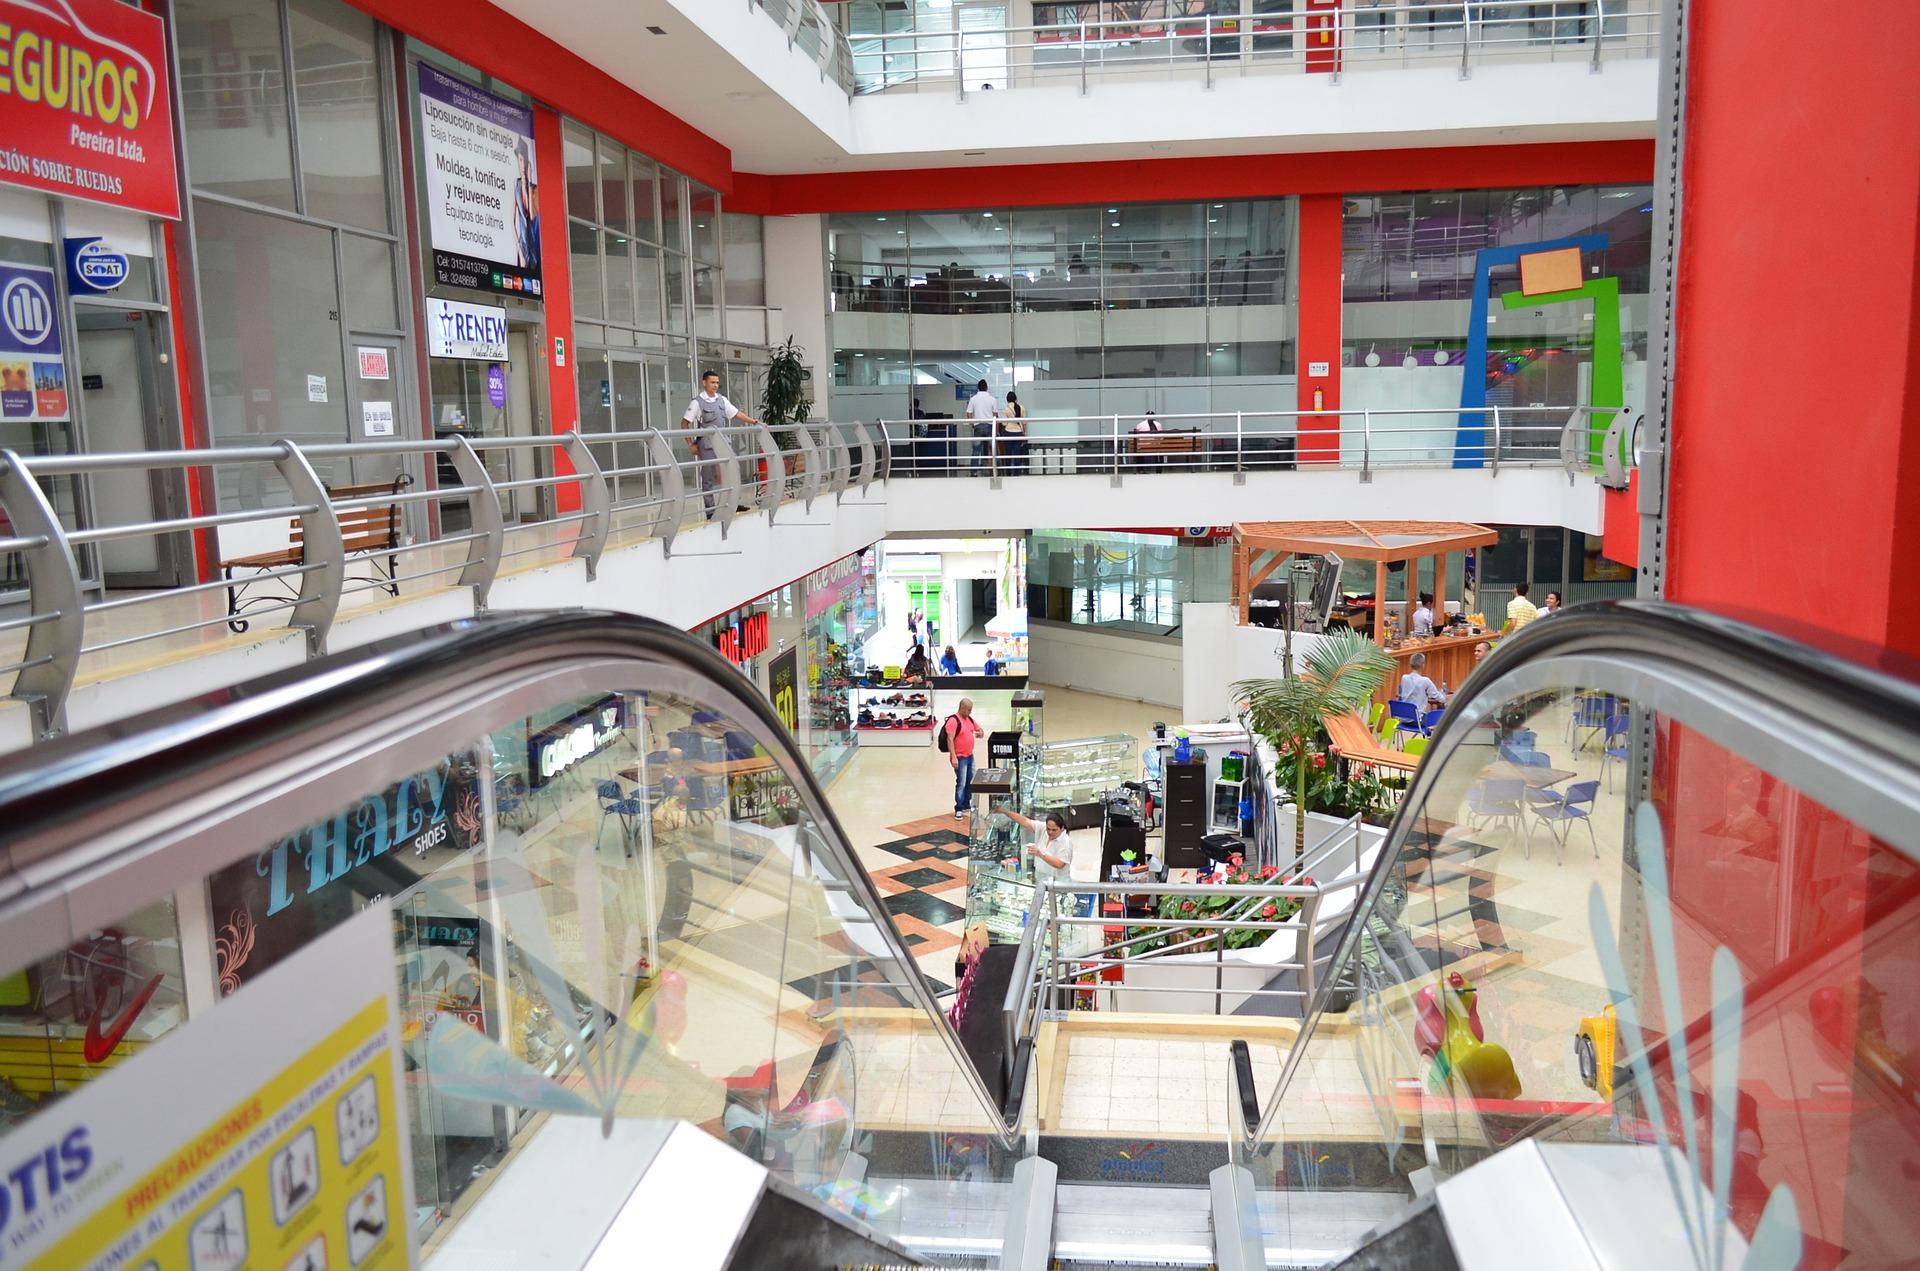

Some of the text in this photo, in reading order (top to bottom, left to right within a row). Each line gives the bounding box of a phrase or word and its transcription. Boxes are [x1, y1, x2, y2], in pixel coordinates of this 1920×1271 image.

[453, 94, 466, 106] para
[425, 100, 514, 149] Liposucción sin cirugía
[430, 124, 447, 144] Baja
[447, 130, 467, 149] hasta
[468, 138, 473, 150] 6
[474, 143, 483, 154] cm
[71, 124, 146, 164] Pereira Ltda.
[32, 158, 74, 185] SOBRE
[75, 168, 123, 195] RUEDAS
[436, 153, 506, 191] Moldea, tonifica
[446, 183, 501, 210] y rejuvenece
[446, 203, 504, 230] Equipos de última
[459, 227, 495, 248] tecnología.
[437, 255, 450, 268] Cel:
[438, 271, 450, 282] Tel:
[455, 312, 507, 344] RENEW
[489, 377, 503, 390] 30%
[720, 611, 769, 666] BIG JOHN
[992, 745, 1013, 753] STORM
[415, 823, 447, 856] SHOES
[126, 1097, 262, 1220] PRECAUCIONES
[170, 1149, 246, 1216] TRANSITAR
[247, 1124, 273, 1151] POR
